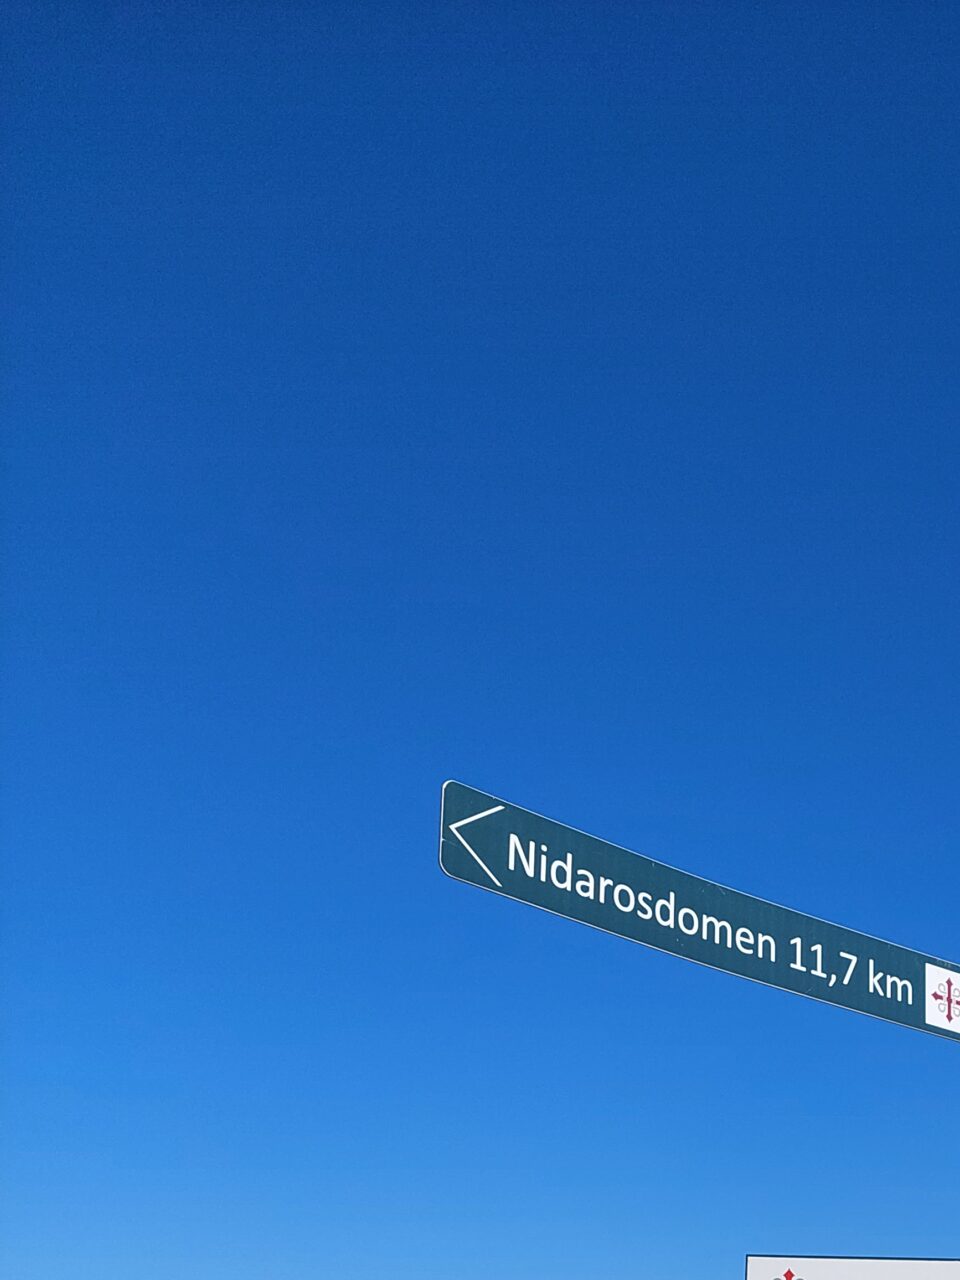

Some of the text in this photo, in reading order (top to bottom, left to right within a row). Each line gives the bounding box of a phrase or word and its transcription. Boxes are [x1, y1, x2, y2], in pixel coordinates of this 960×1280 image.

[508, 834, 913, 1004] Nidarosdomen 11,7 km
